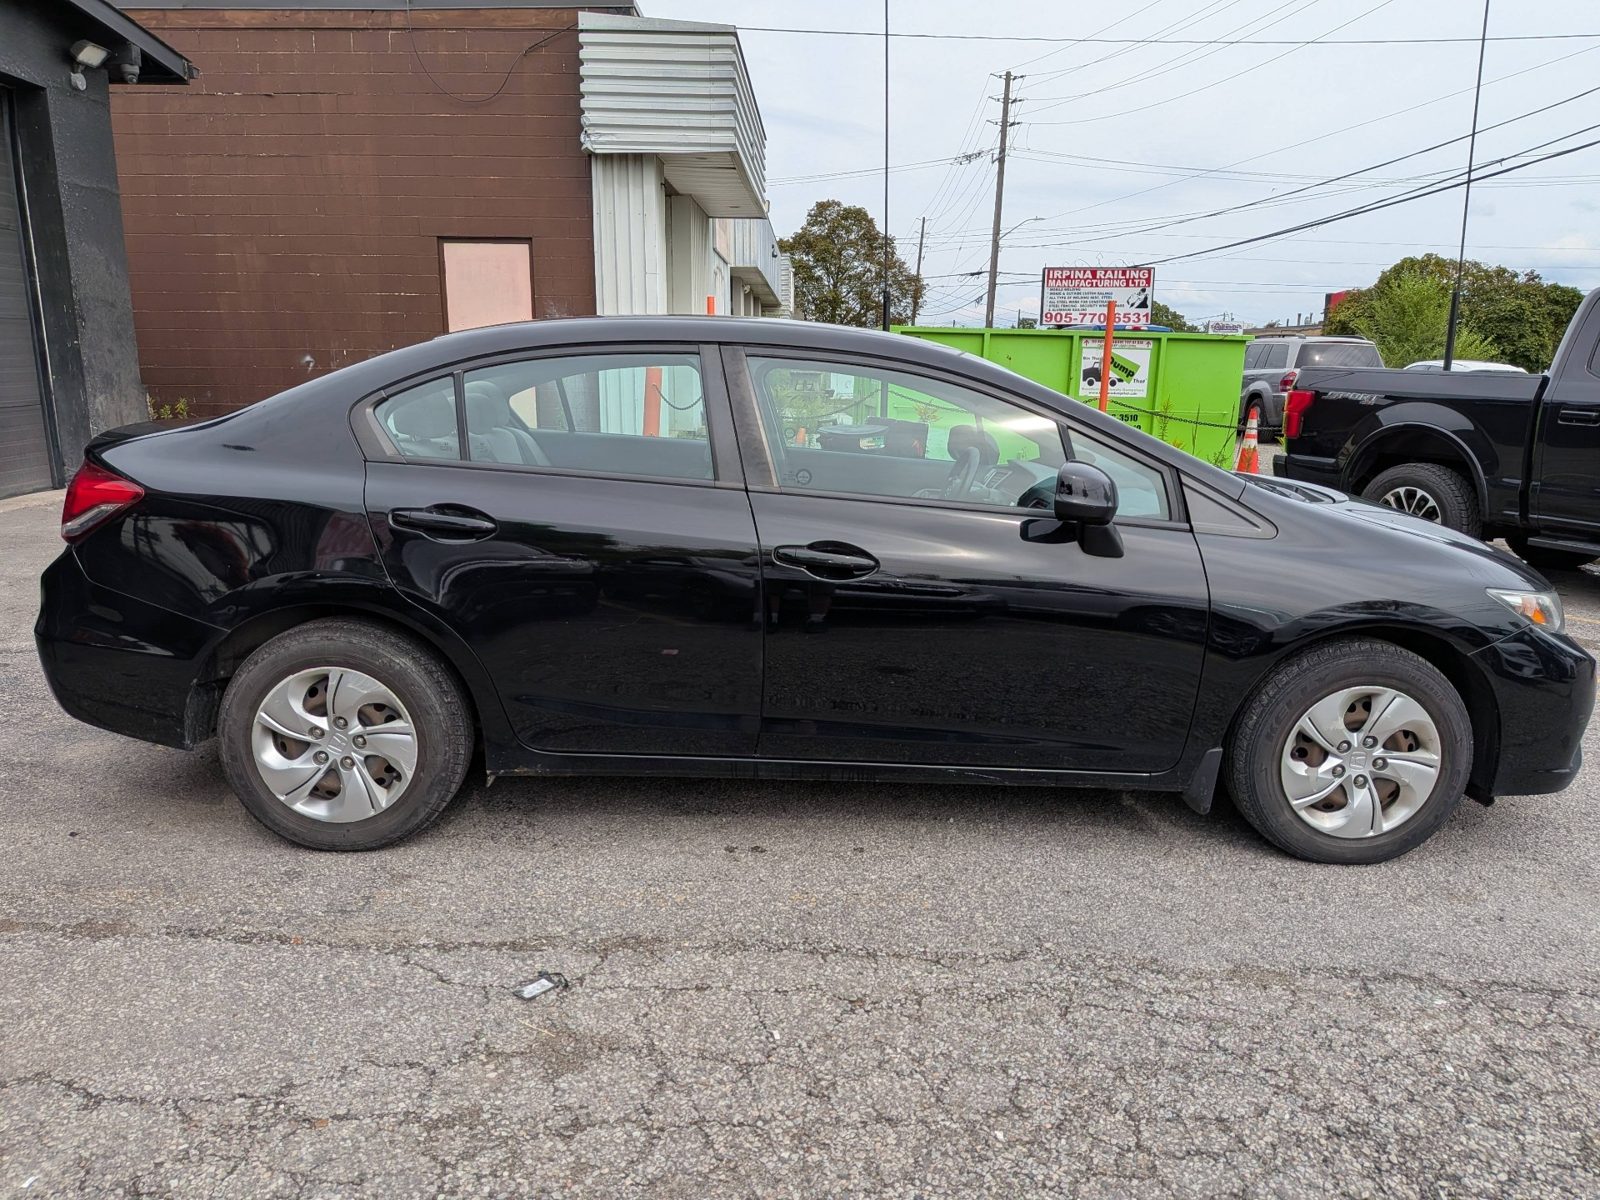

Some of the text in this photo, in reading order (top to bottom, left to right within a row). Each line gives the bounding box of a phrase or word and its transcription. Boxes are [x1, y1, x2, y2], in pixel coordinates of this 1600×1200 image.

[1049, 270, 1149, 279] IRPINA RAILING
[1048, 279, 1148, 287] MANUFACTURING LTD.
[1044, 312, 1149, 323] 905-7706531
